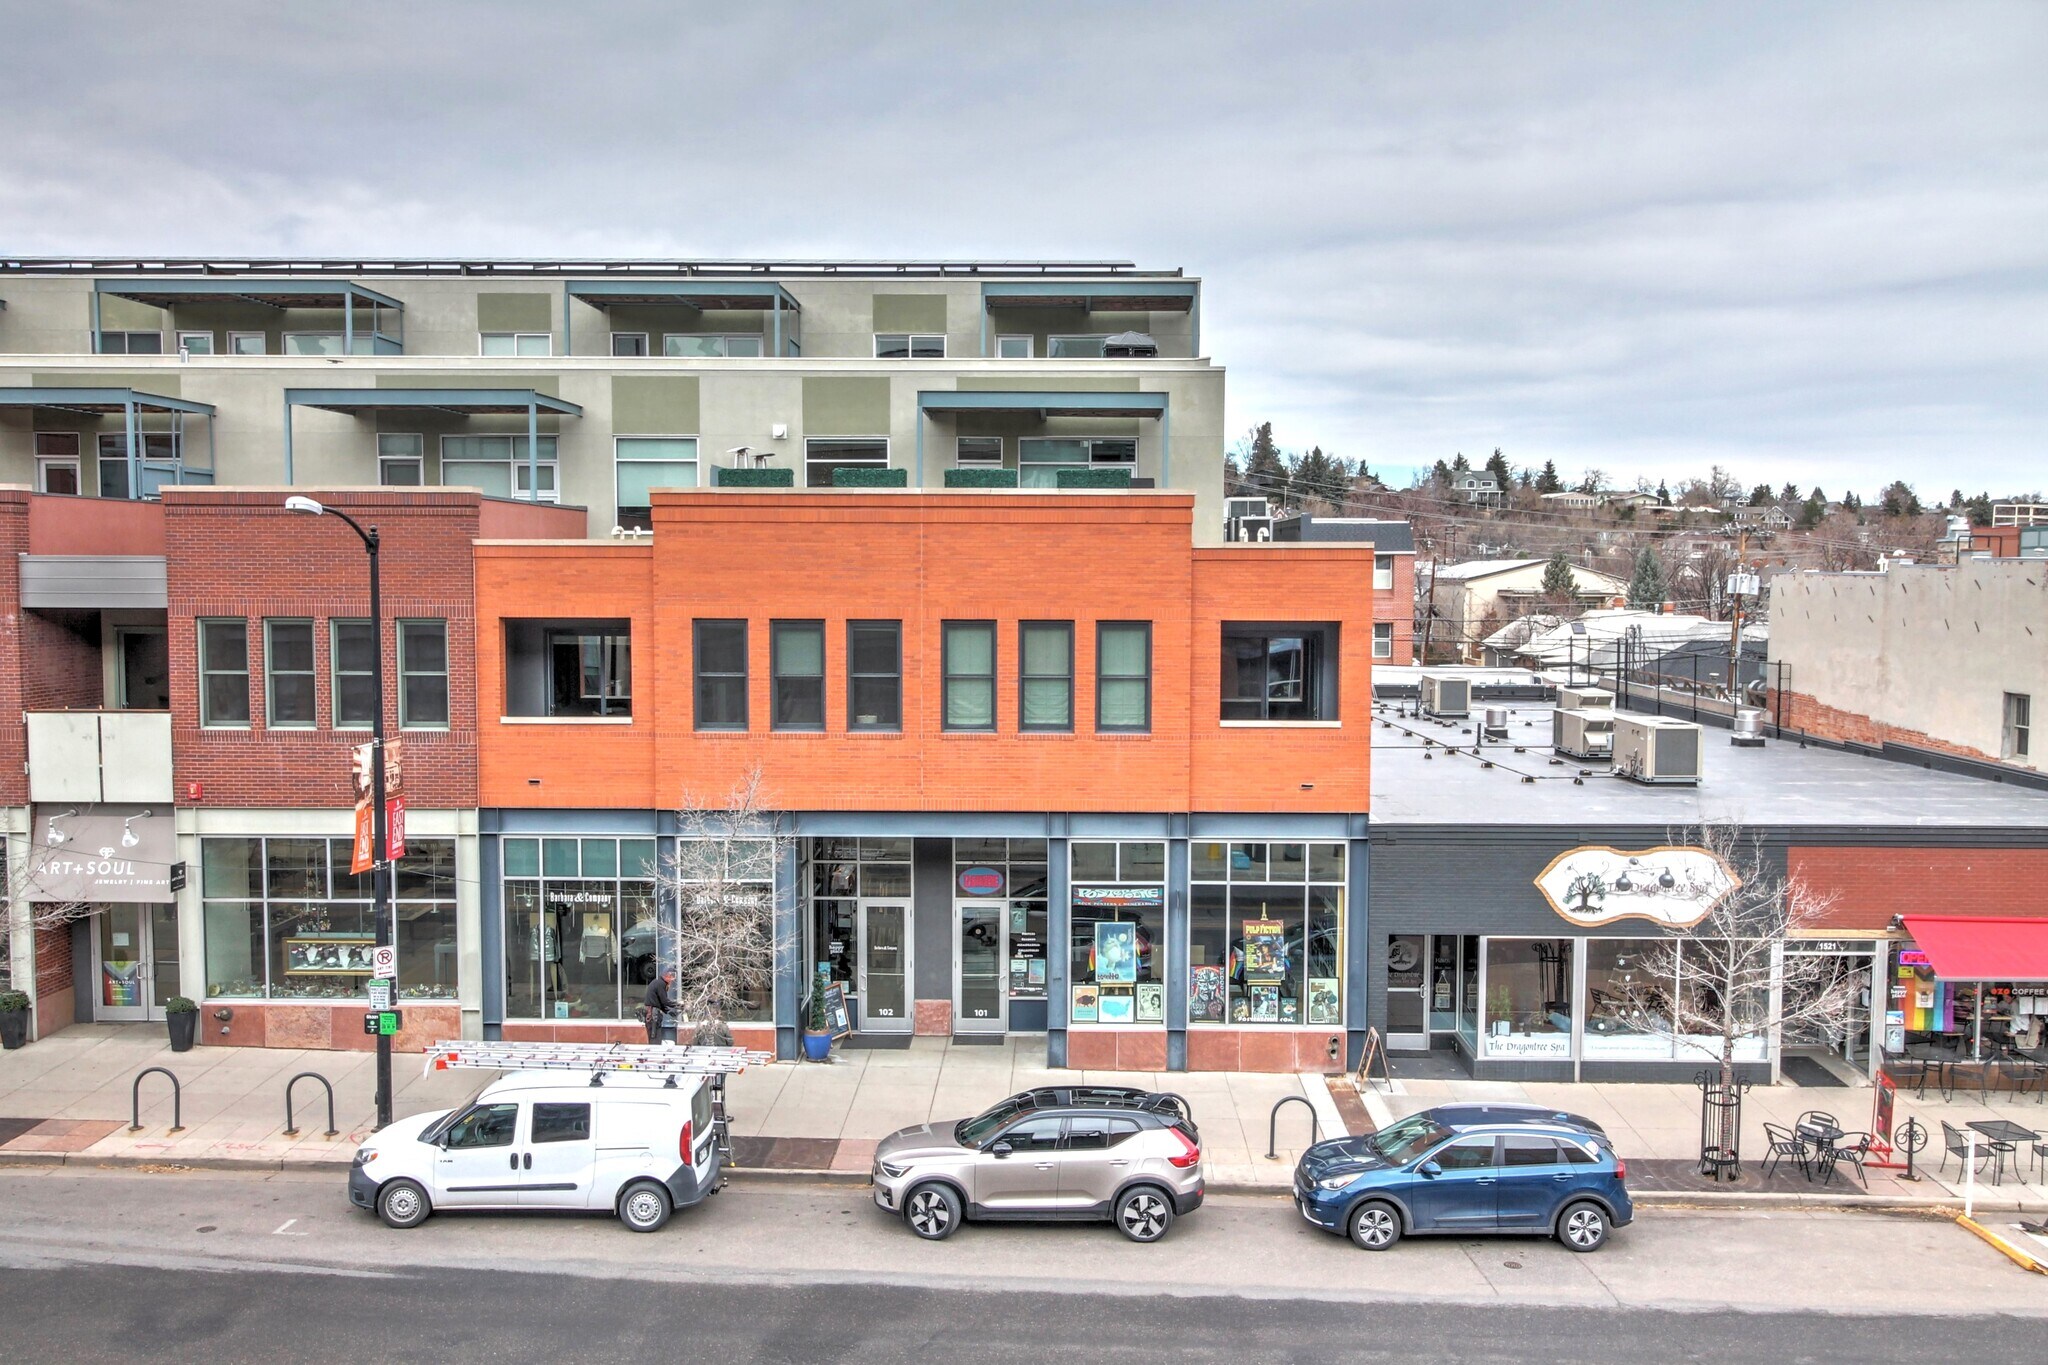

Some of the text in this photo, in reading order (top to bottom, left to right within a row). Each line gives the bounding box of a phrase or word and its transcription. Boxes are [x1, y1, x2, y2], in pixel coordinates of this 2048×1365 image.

[392, 809, 404, 827] EAST
[392, 825, 404, 844] END
[36, 861, 136, 876] ART+SOUL
[550, 892, 612, 904] Barbara & Company
[1245, 924, 1281, 934] PULP FICTION
[1819, 942, 1837, 950] 1521
[1990, 987, 2011, 996] OZO
[878, 1008, 894, 1016] 102
[974, 1009, 988, 1017] 101
[1489, 1041, 1566, 1056] The Dragontree Spa
